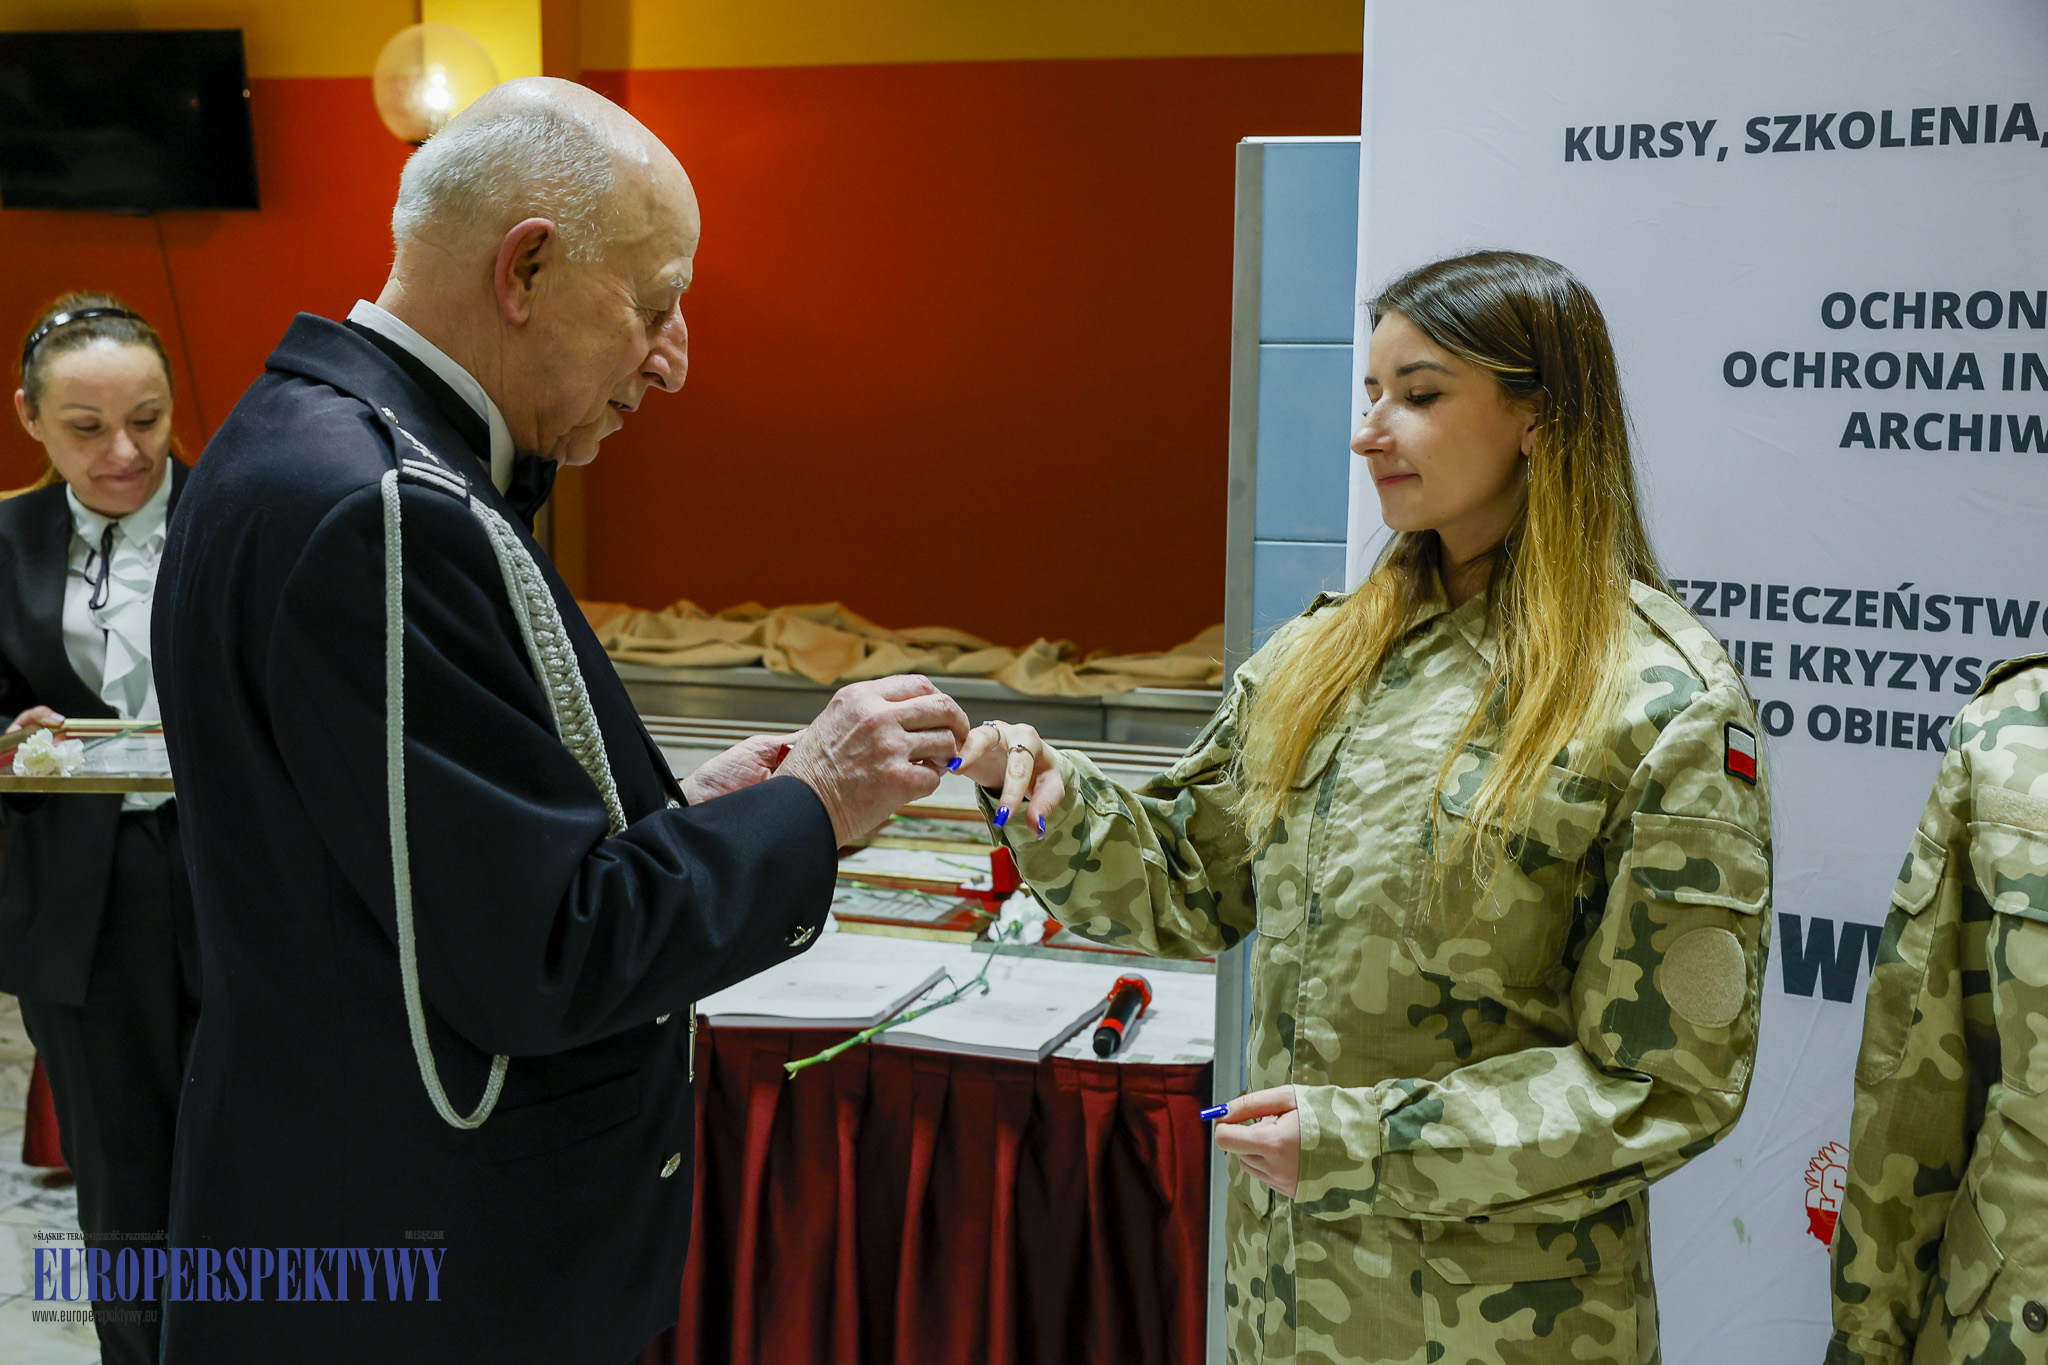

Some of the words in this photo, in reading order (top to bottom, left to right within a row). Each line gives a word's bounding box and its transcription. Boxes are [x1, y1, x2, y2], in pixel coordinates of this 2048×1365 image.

[1564, 119, 1728, 162] KURSY,
[1744, 102, 2048, 154] SZKOLENIA,
[1821, 290, 2048, 330] OCHRON
[1722, 351, 1985, 391] OCHRONA
[1839, 411, 2048, 454] ARCHIW
[1668, 579, 2048, 639] ZPIECZEŃSTW
[1720, 639, 1773, 679] IE
[1807, 704, 1954, 753] OBIEK
[1778, 912, 1884, 1004] W
